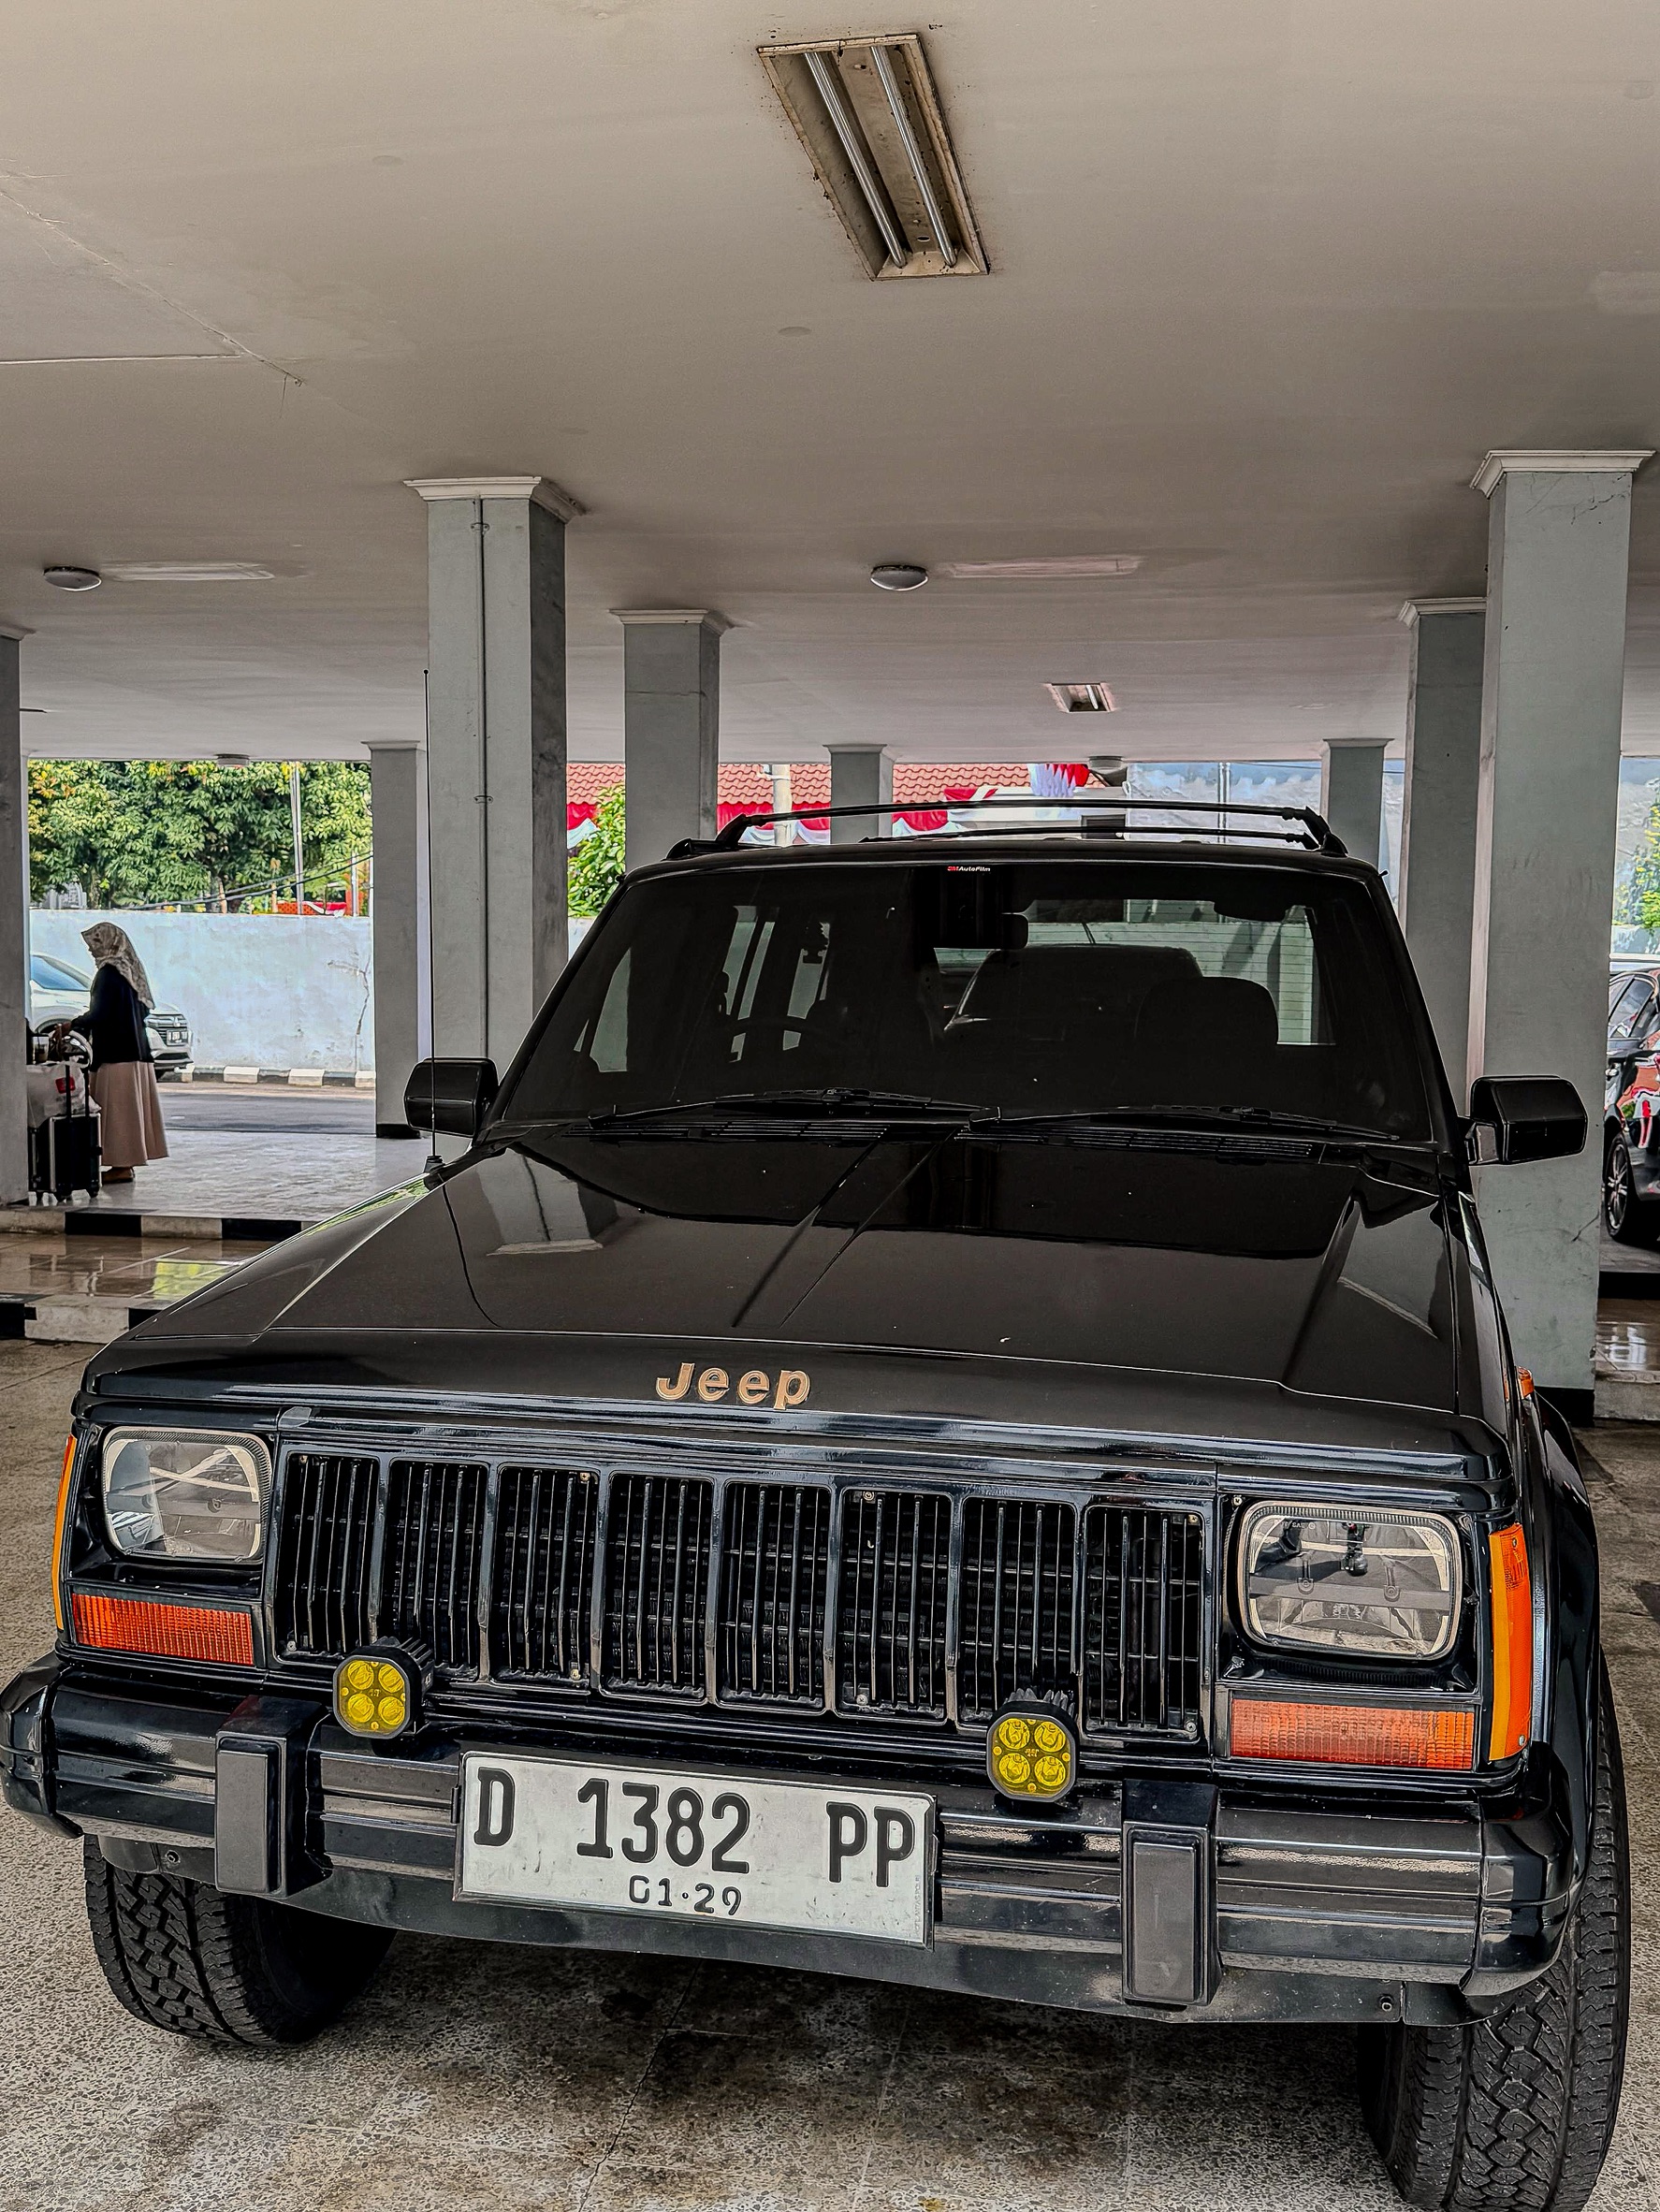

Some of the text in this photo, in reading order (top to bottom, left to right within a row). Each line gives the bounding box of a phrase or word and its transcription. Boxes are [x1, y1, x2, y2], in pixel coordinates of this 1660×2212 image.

[656, 1362, 810, 1410] Jeep
[473, 1767, 915, 1888] D 1382 PP
